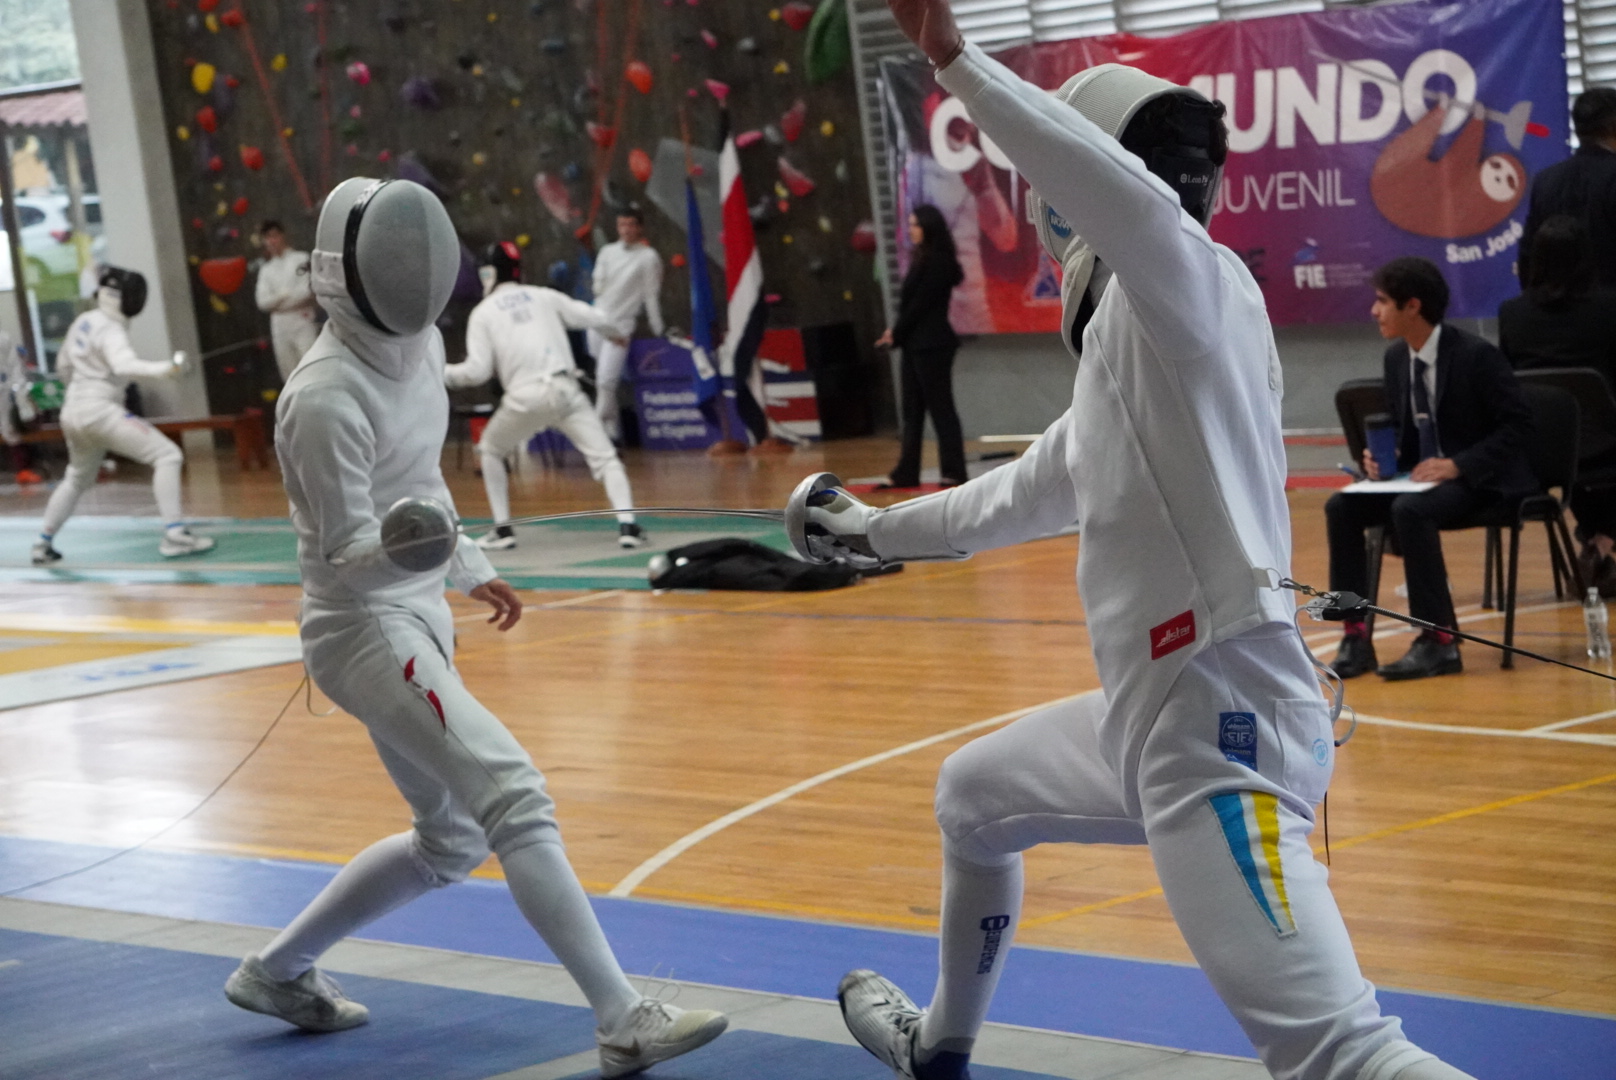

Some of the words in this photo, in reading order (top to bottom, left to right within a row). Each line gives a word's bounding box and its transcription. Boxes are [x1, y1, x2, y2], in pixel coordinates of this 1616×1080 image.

[1212, 168, 1355, 215] JUVENIL
[1445, 243, 1483, 264] San
[1294, 264, 1327, 289] FIE
